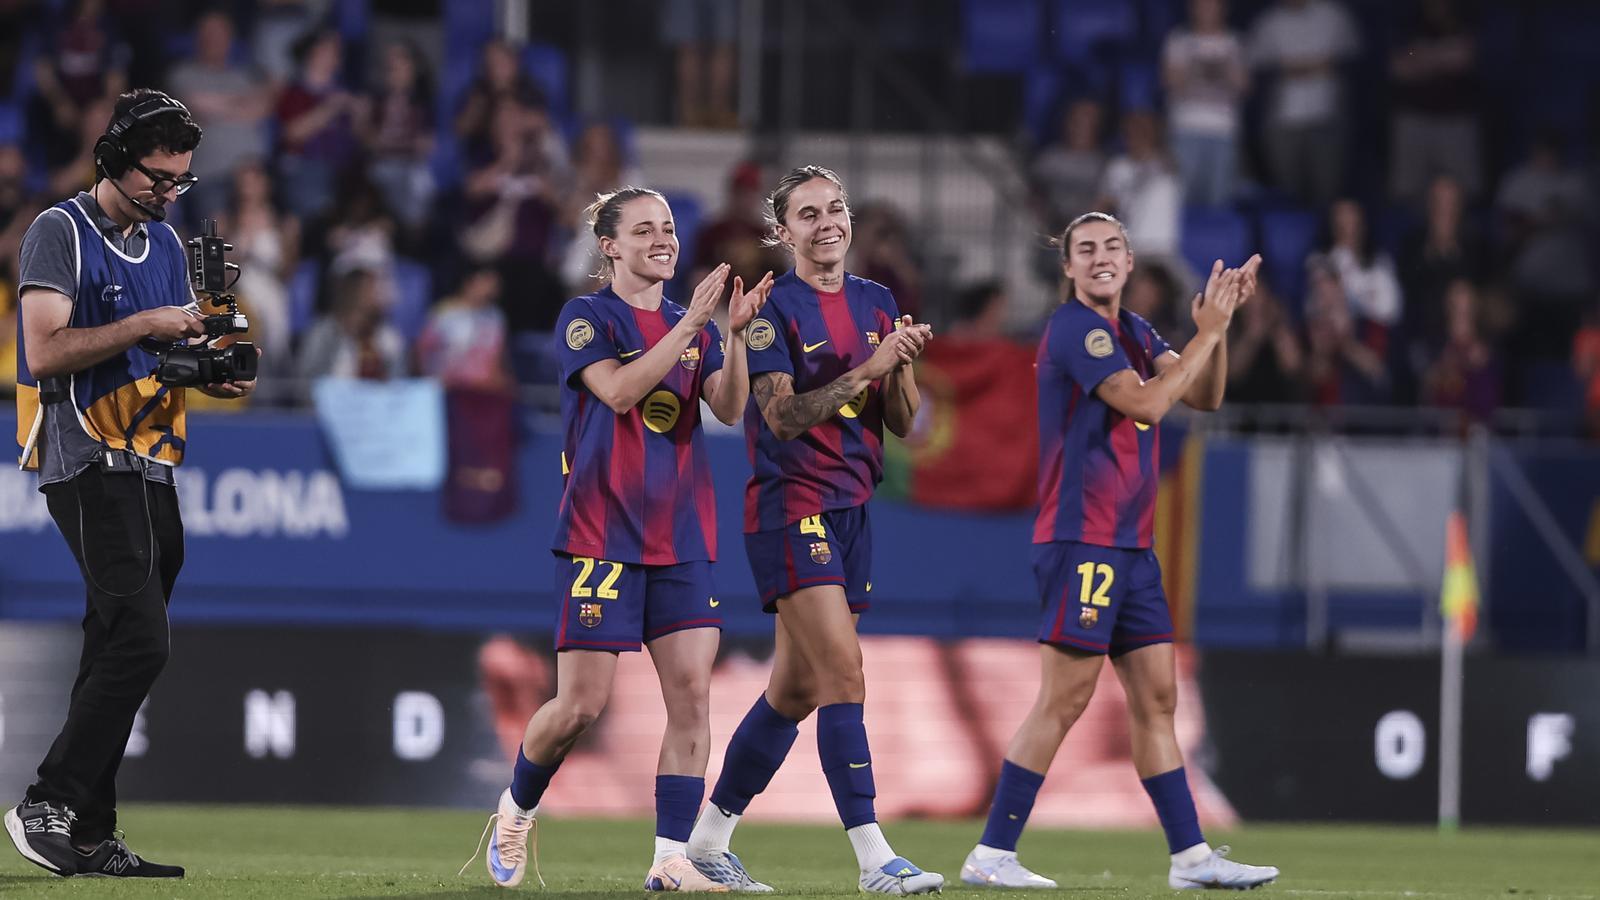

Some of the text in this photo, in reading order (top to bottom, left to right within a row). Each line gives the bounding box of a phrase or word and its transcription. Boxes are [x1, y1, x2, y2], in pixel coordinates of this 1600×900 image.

[800, 514, 826, 538] 4
[571, 556, 623, 599] 22
[1077, 561, 1114, 606] 12
